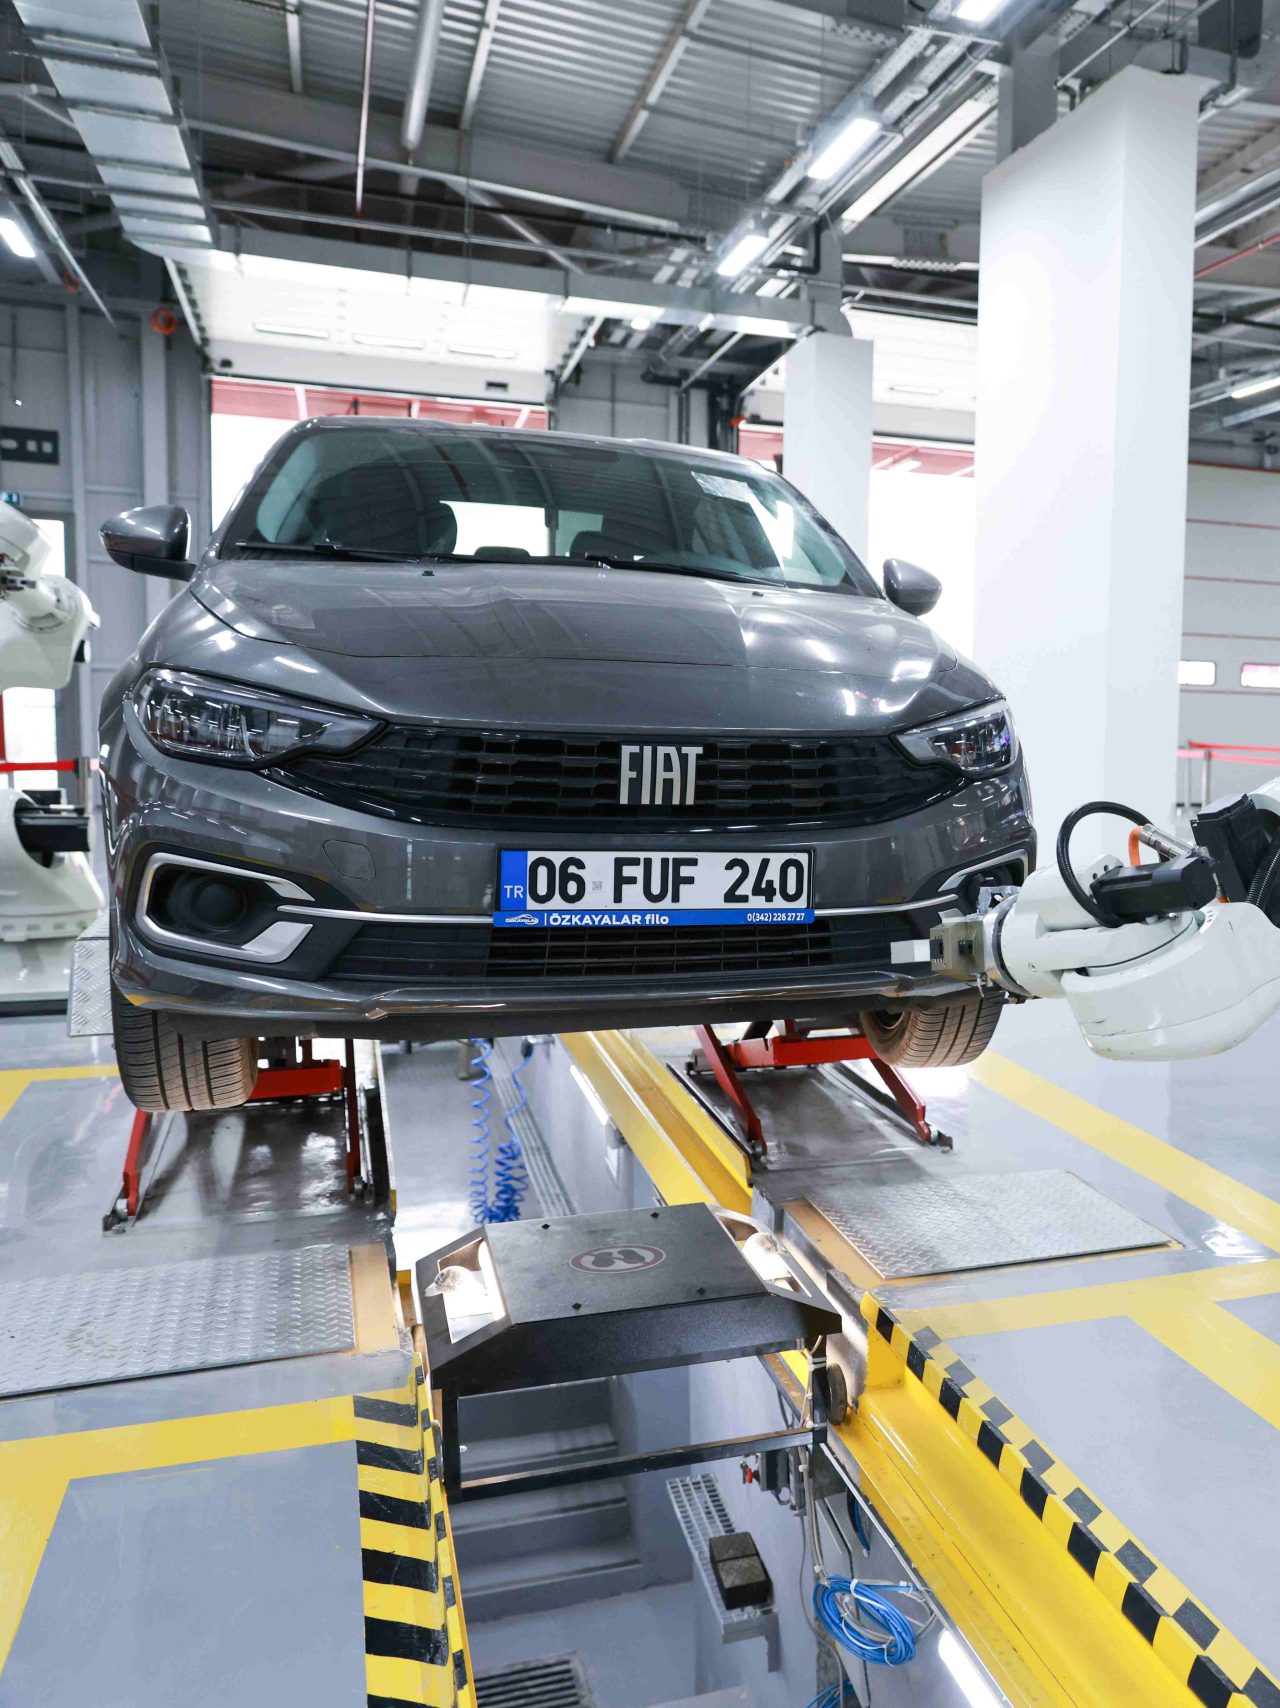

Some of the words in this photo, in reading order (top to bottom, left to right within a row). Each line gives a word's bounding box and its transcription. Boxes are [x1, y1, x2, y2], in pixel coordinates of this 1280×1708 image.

[620, 745, 703, 805] FIAT
[528, 856, 586, 904] 06
[613, 856, 698, 904] FUF
[723, 858, 804, 904] 240
[504, 886, 524, 898] TR
[550, 913, 641, 926] ÖZKAYALAR
[747, 912, 772, 923] 0(342)
[773, 913, 788, 922] 226
